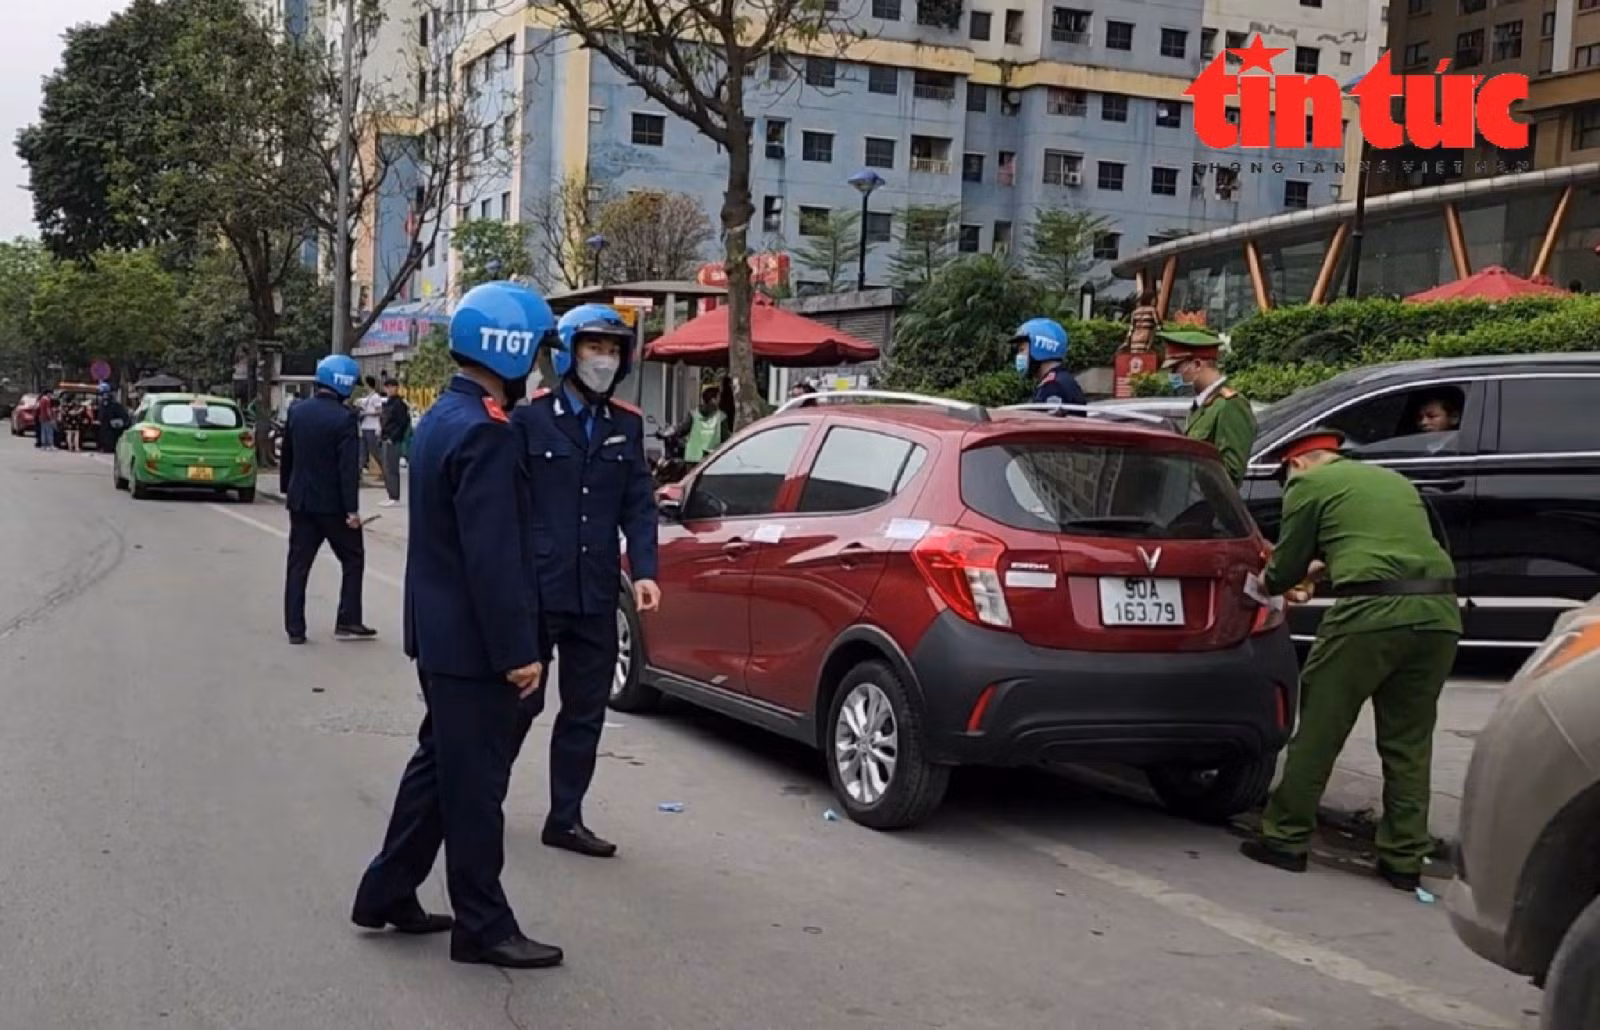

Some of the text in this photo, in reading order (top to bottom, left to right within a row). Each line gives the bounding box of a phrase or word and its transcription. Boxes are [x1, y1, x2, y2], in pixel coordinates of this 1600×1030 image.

[480, 327, 534, 356] TTGT
[1034, 335, 1060, 352] TTGT
[1124, 578, 1159, 599] 90A
[1114, 602, 1176, 622] 163.79
